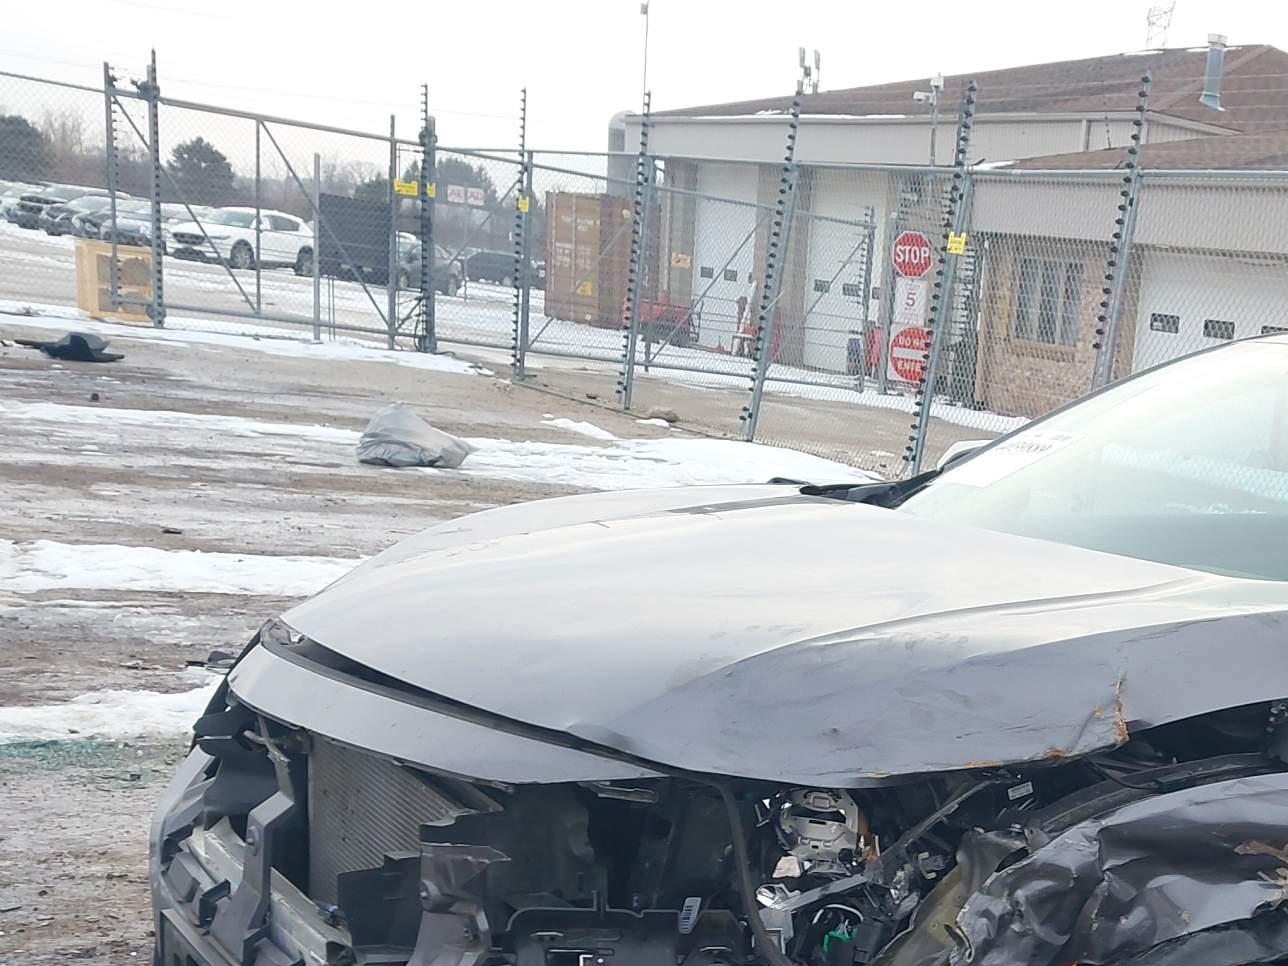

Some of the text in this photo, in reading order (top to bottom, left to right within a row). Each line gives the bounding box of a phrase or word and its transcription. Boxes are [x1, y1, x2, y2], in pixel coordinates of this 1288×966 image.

[895, 245, 930, 264] STOP
[905, 292, 917, 307] 5
[898, 336, 912, 346] DO
